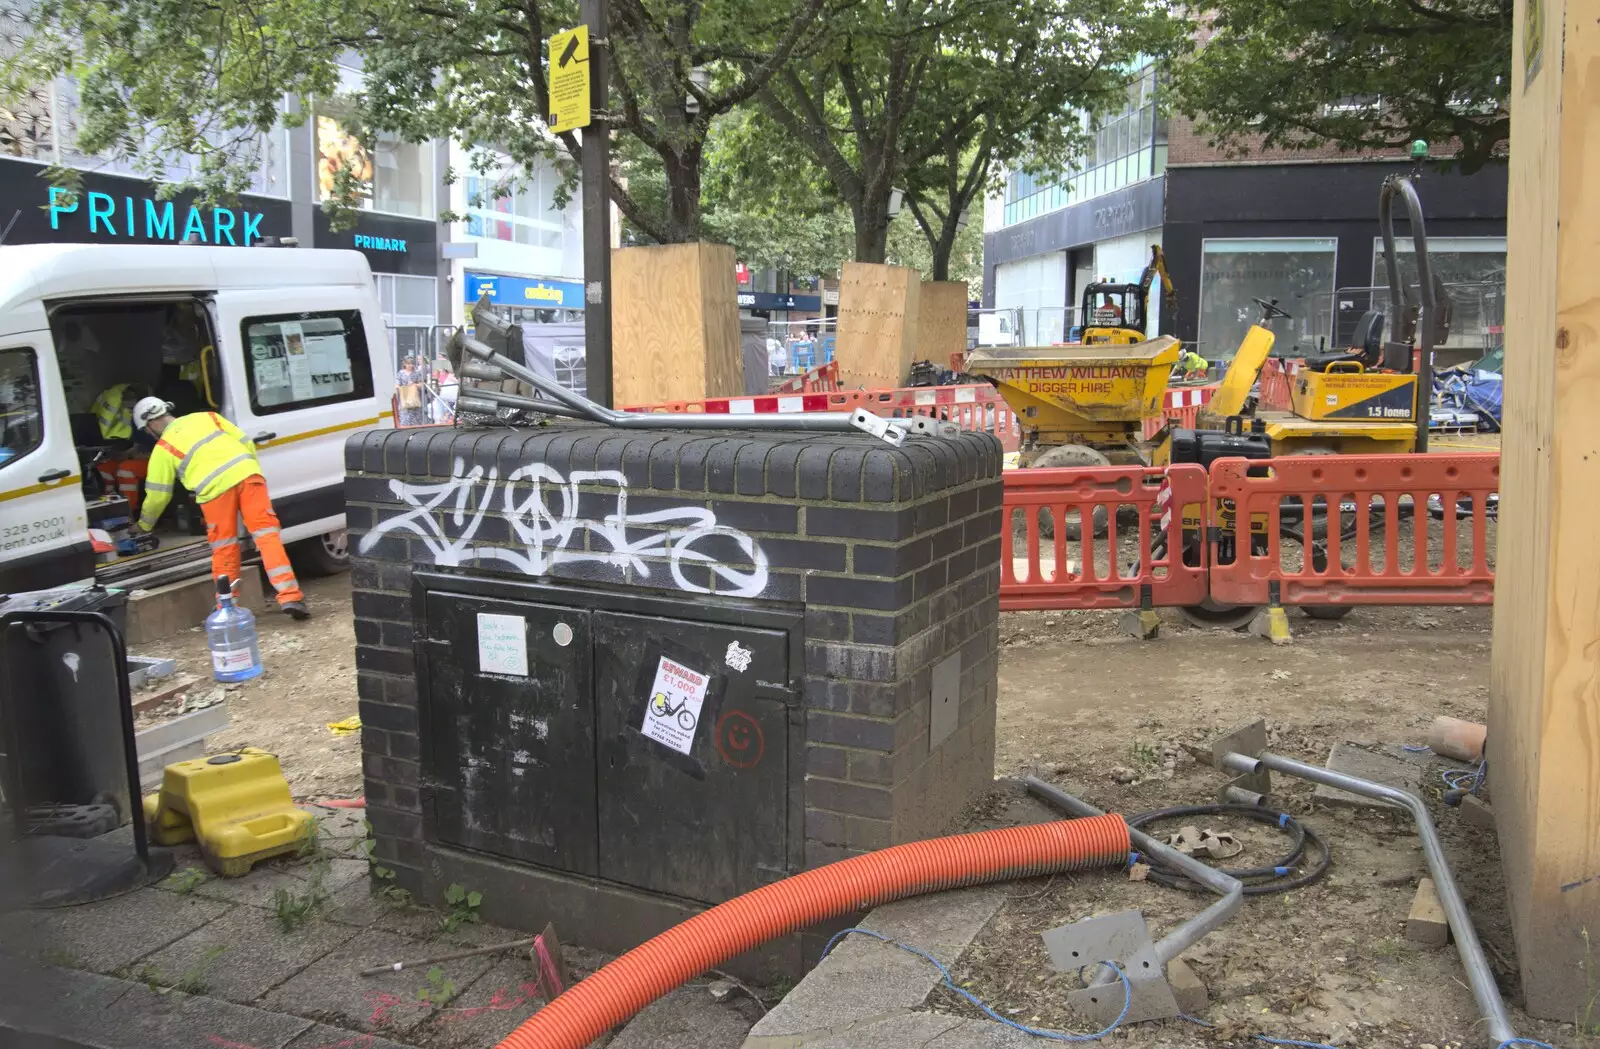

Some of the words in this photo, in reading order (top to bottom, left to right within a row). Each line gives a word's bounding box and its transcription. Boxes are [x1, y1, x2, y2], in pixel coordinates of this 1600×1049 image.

[49, 186, 265, 247] PRIMARK
[354, 234, 408, 253] PRIMARK
[1071, 367, 1147, 379] WILLIAMS
[1029, 382, 1077, 393] DIGGER
[1081, 382, 1111, 393] HIRE
[1367, 406, 1382, 417] 1.5
[1384, 406, 1411, 418] tonne
[2, 523, 29, 538] 328
[32, 516, 66, 531] 9001
[662, 661, 703, 686] REWARD
[663, 673, 695, 694] £1,000
